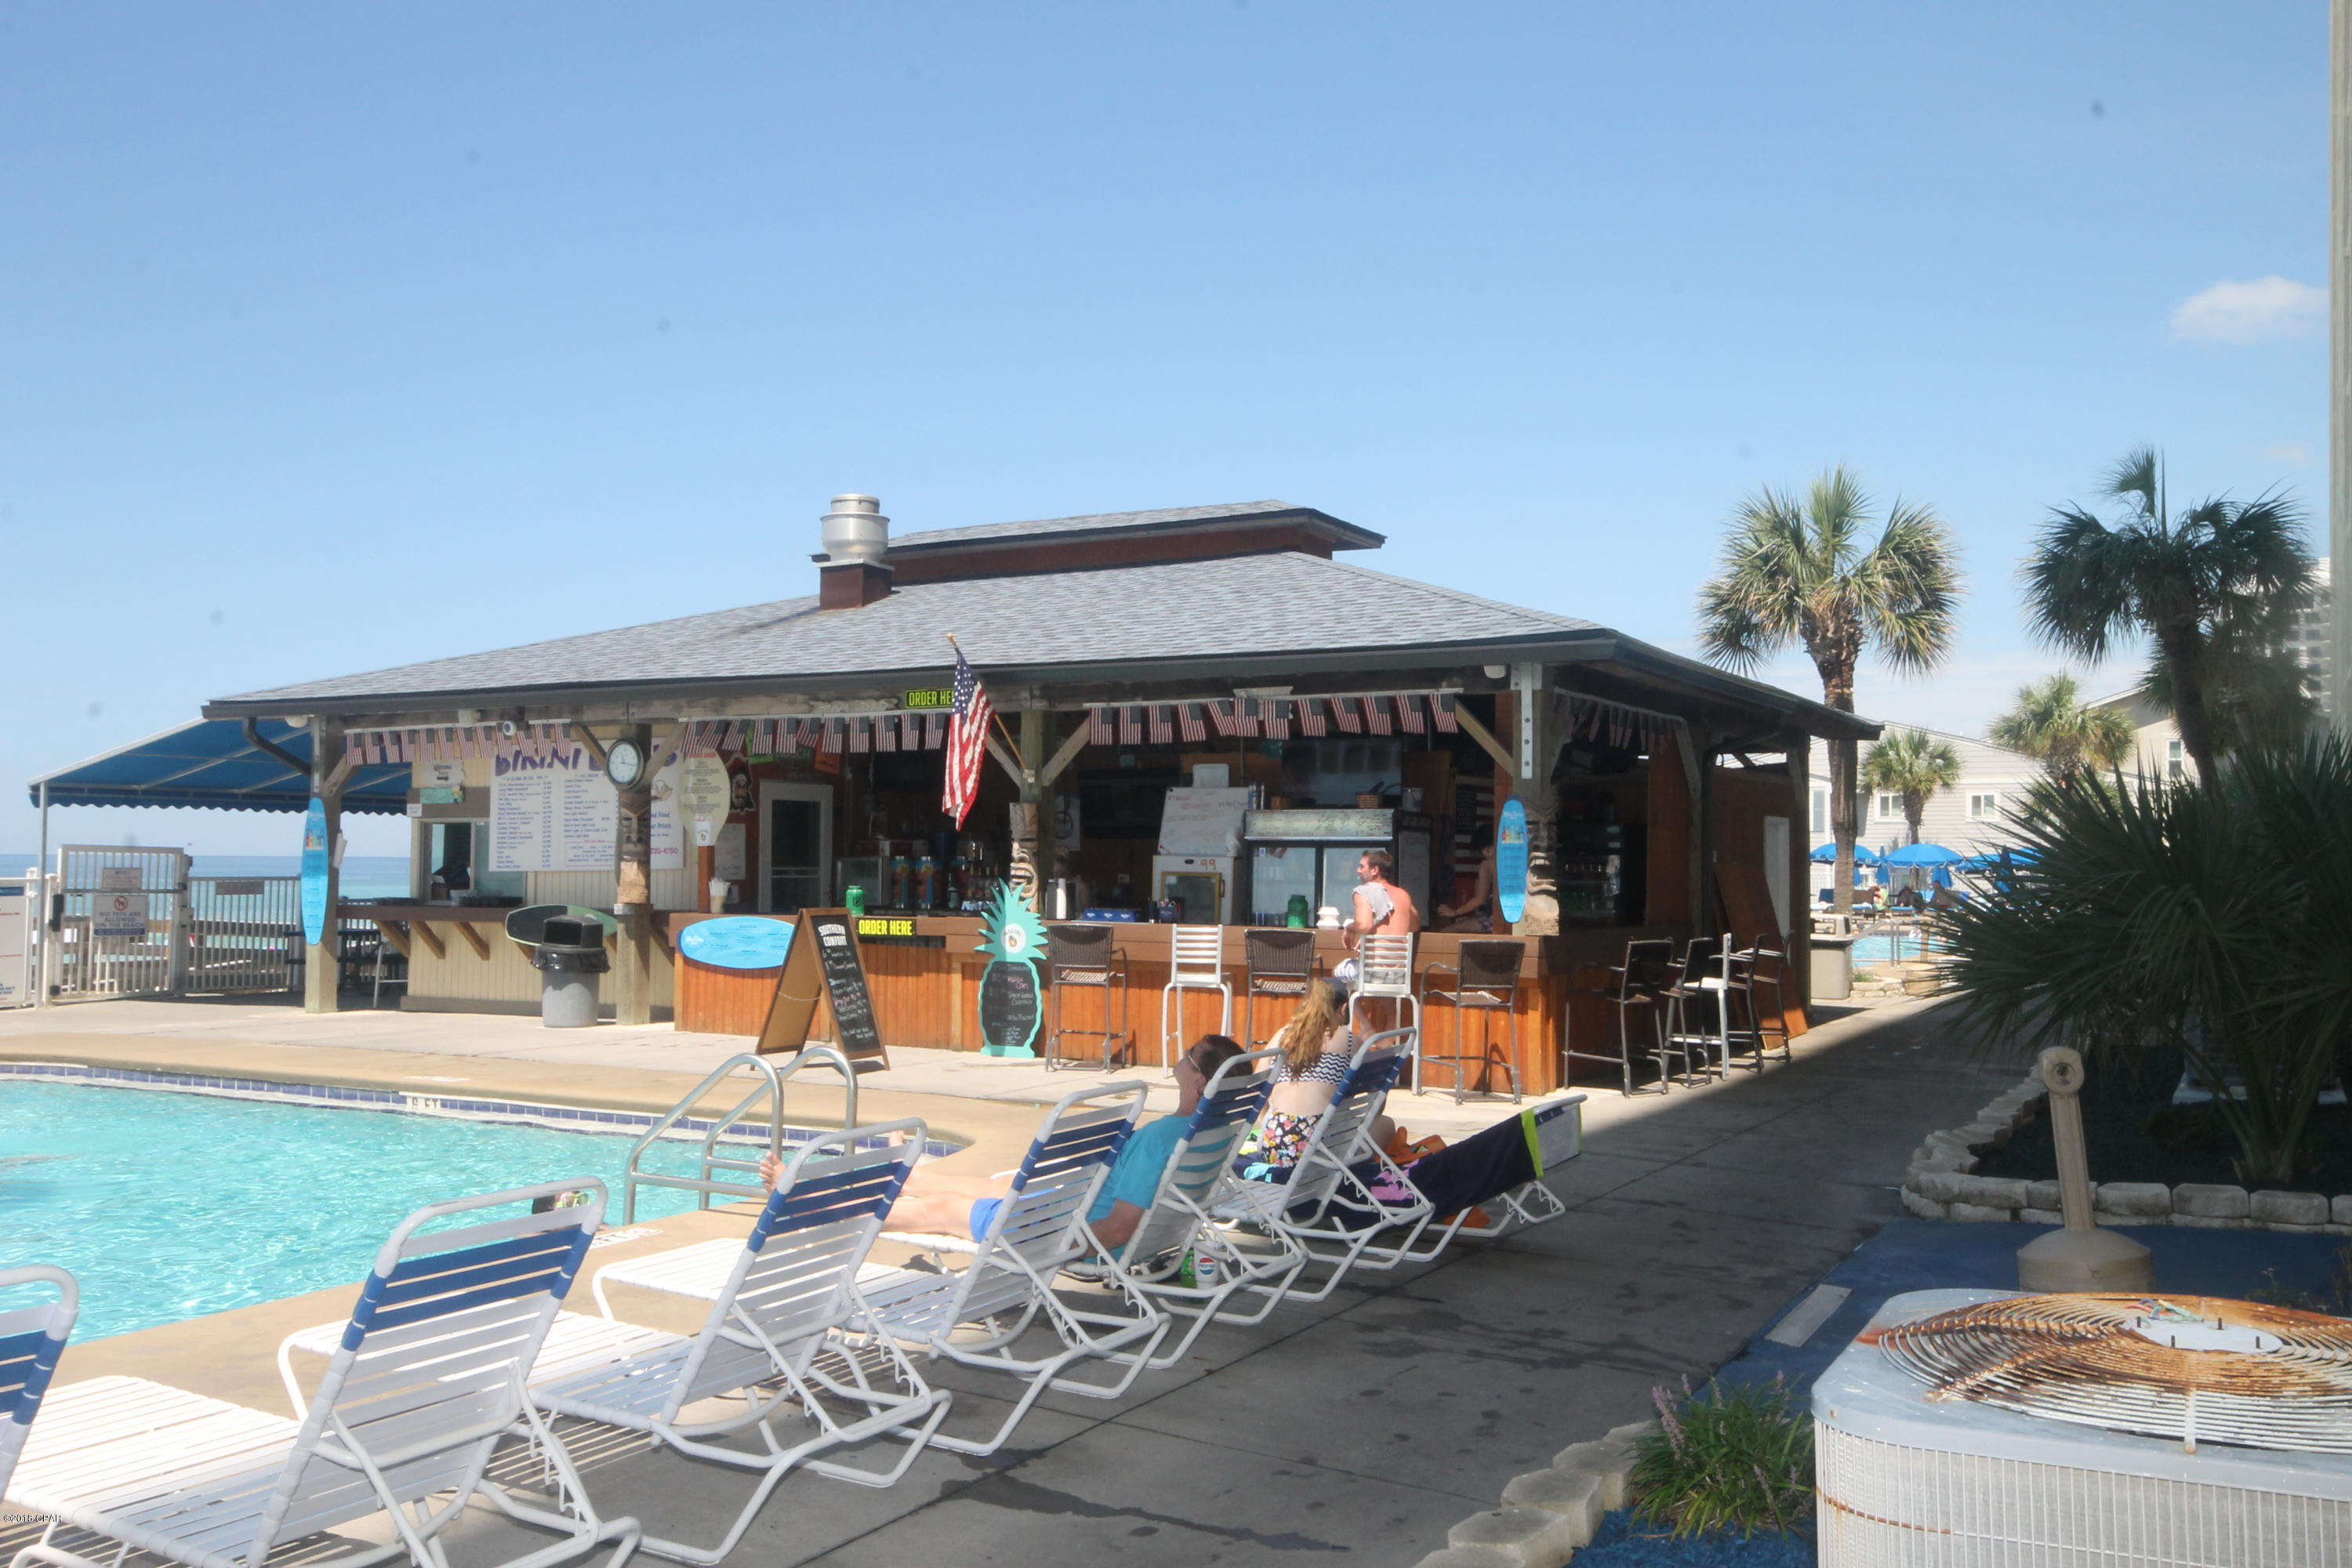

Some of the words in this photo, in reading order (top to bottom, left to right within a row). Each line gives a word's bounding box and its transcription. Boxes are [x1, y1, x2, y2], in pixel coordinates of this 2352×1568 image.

[909, 691, 937, 706] ORDER
[941, 690, 954, 705] HE
[818, 924, 846, 936] SOUTHERN
[858, 920, 887, 935] ORDER
[890, 920, 913, 936] HERE
[822, 935, 847, 947] COMFORT
